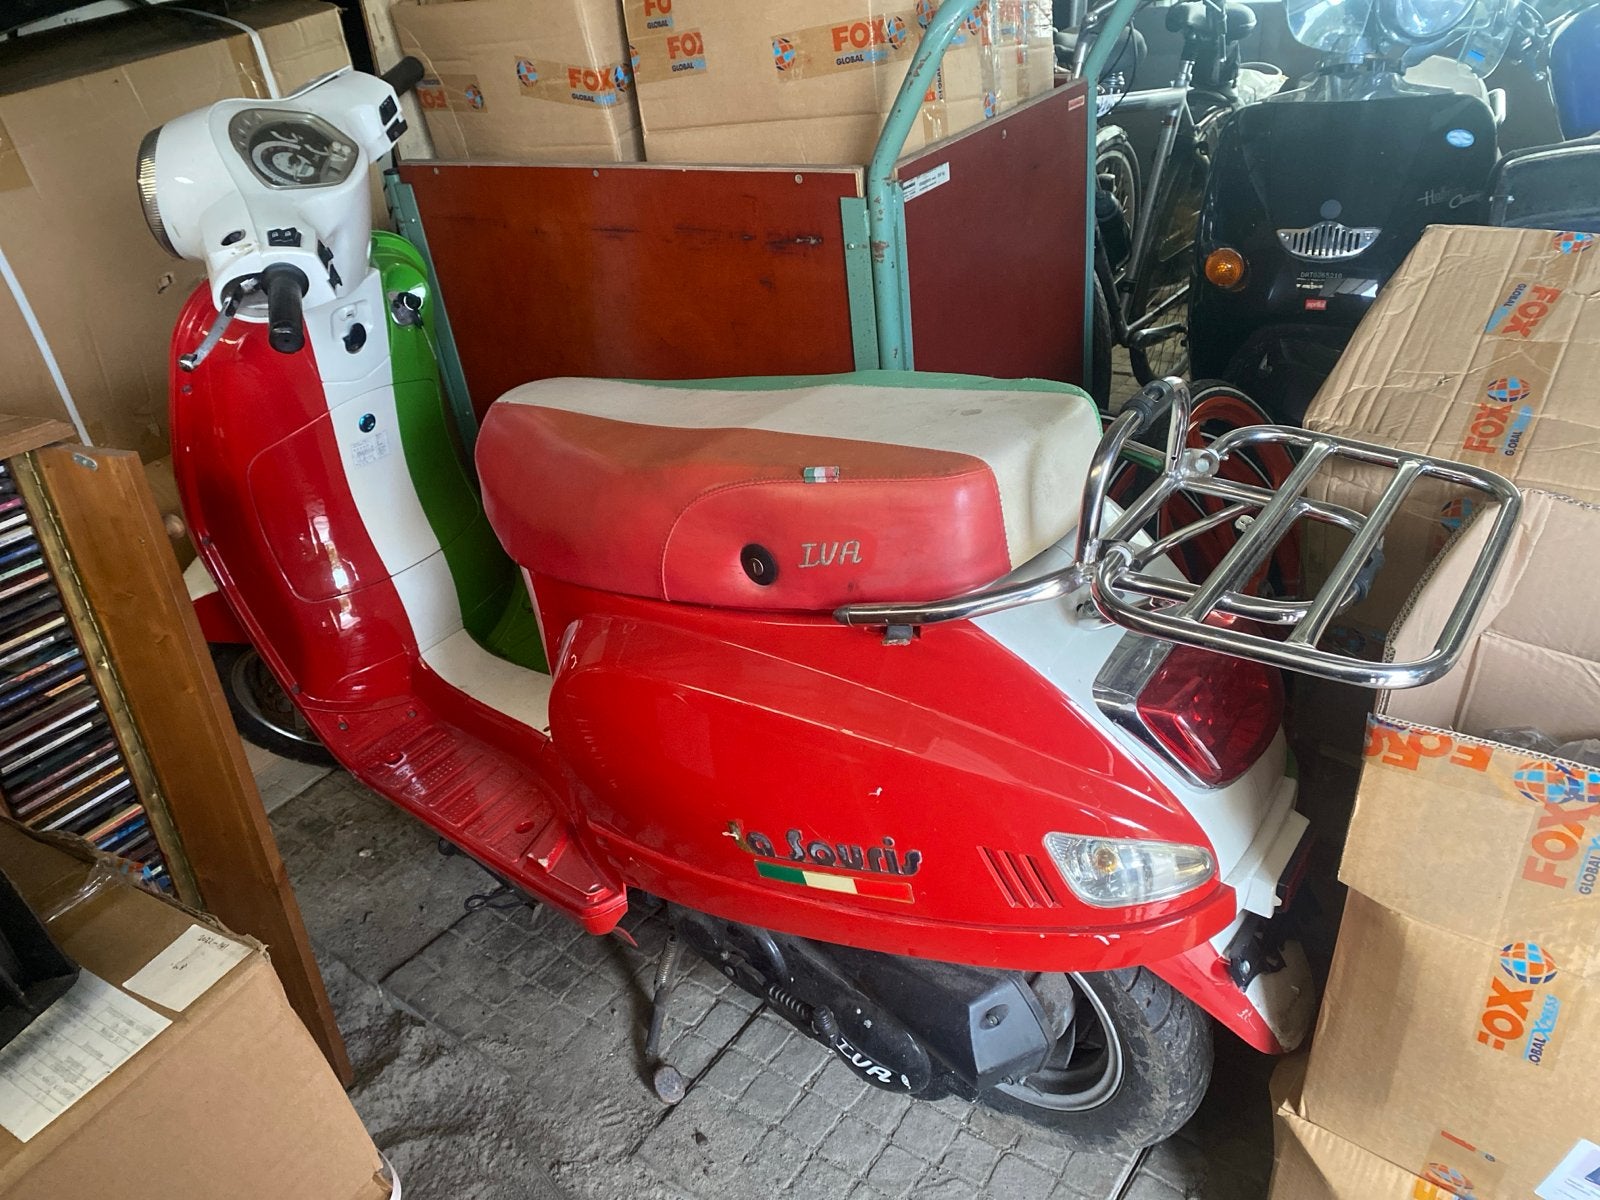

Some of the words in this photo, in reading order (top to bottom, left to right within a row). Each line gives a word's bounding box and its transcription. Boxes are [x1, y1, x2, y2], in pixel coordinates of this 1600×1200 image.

[830, 18, 886, 52] FOX
[836, 54, 864, 66] GLOBAL
[567, 67, 615, 91] FOX
[1501, 285, 1562, 338] FOX
[1503, 283, 1527, 307] GLOBAL
[1462, 402, 1513, 454] FOX
[798, 540, 862, 569] IVA
[785, 828, 923, 876] Souris
[1522, 800, 1600, 890] FOX
